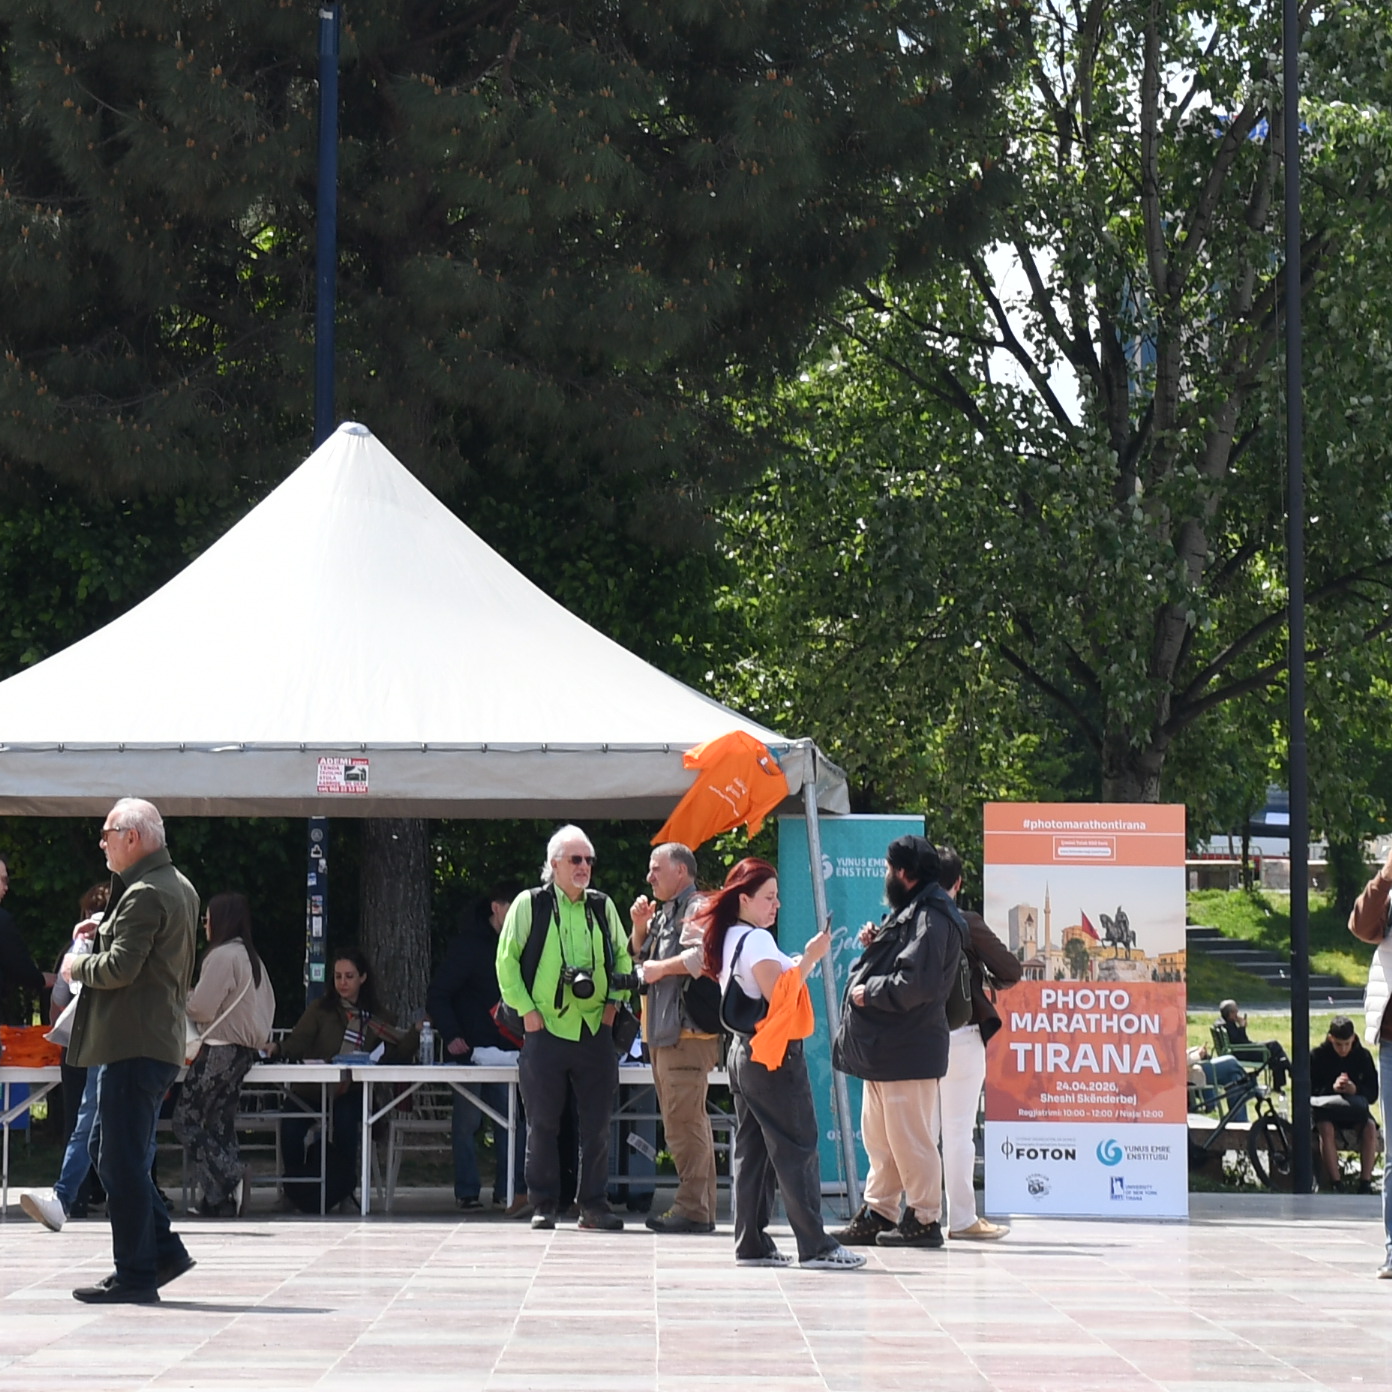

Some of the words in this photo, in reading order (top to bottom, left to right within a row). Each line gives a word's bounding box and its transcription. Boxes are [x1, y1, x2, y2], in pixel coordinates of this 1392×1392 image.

[319, 757, 352, 765] ADEMI
[1023, 819, 1146, 831] #photomarathontirana
[836, 857, 867, 866] YUNUS
[1041, 988, 1130, 1010] PHOTO
[1011, 1012, 1160, 1034] MARATHON
[1009, 1042, 1162, 1074] TIRANA
[1040, 1093, 1075, 1103] Sheshi
[1077, 1093, 1137, 1105] Skënderbej
[1015, 1148, 1077, 1161] FOTON
[1124, 1145, 1149, 1153] YUNUS
